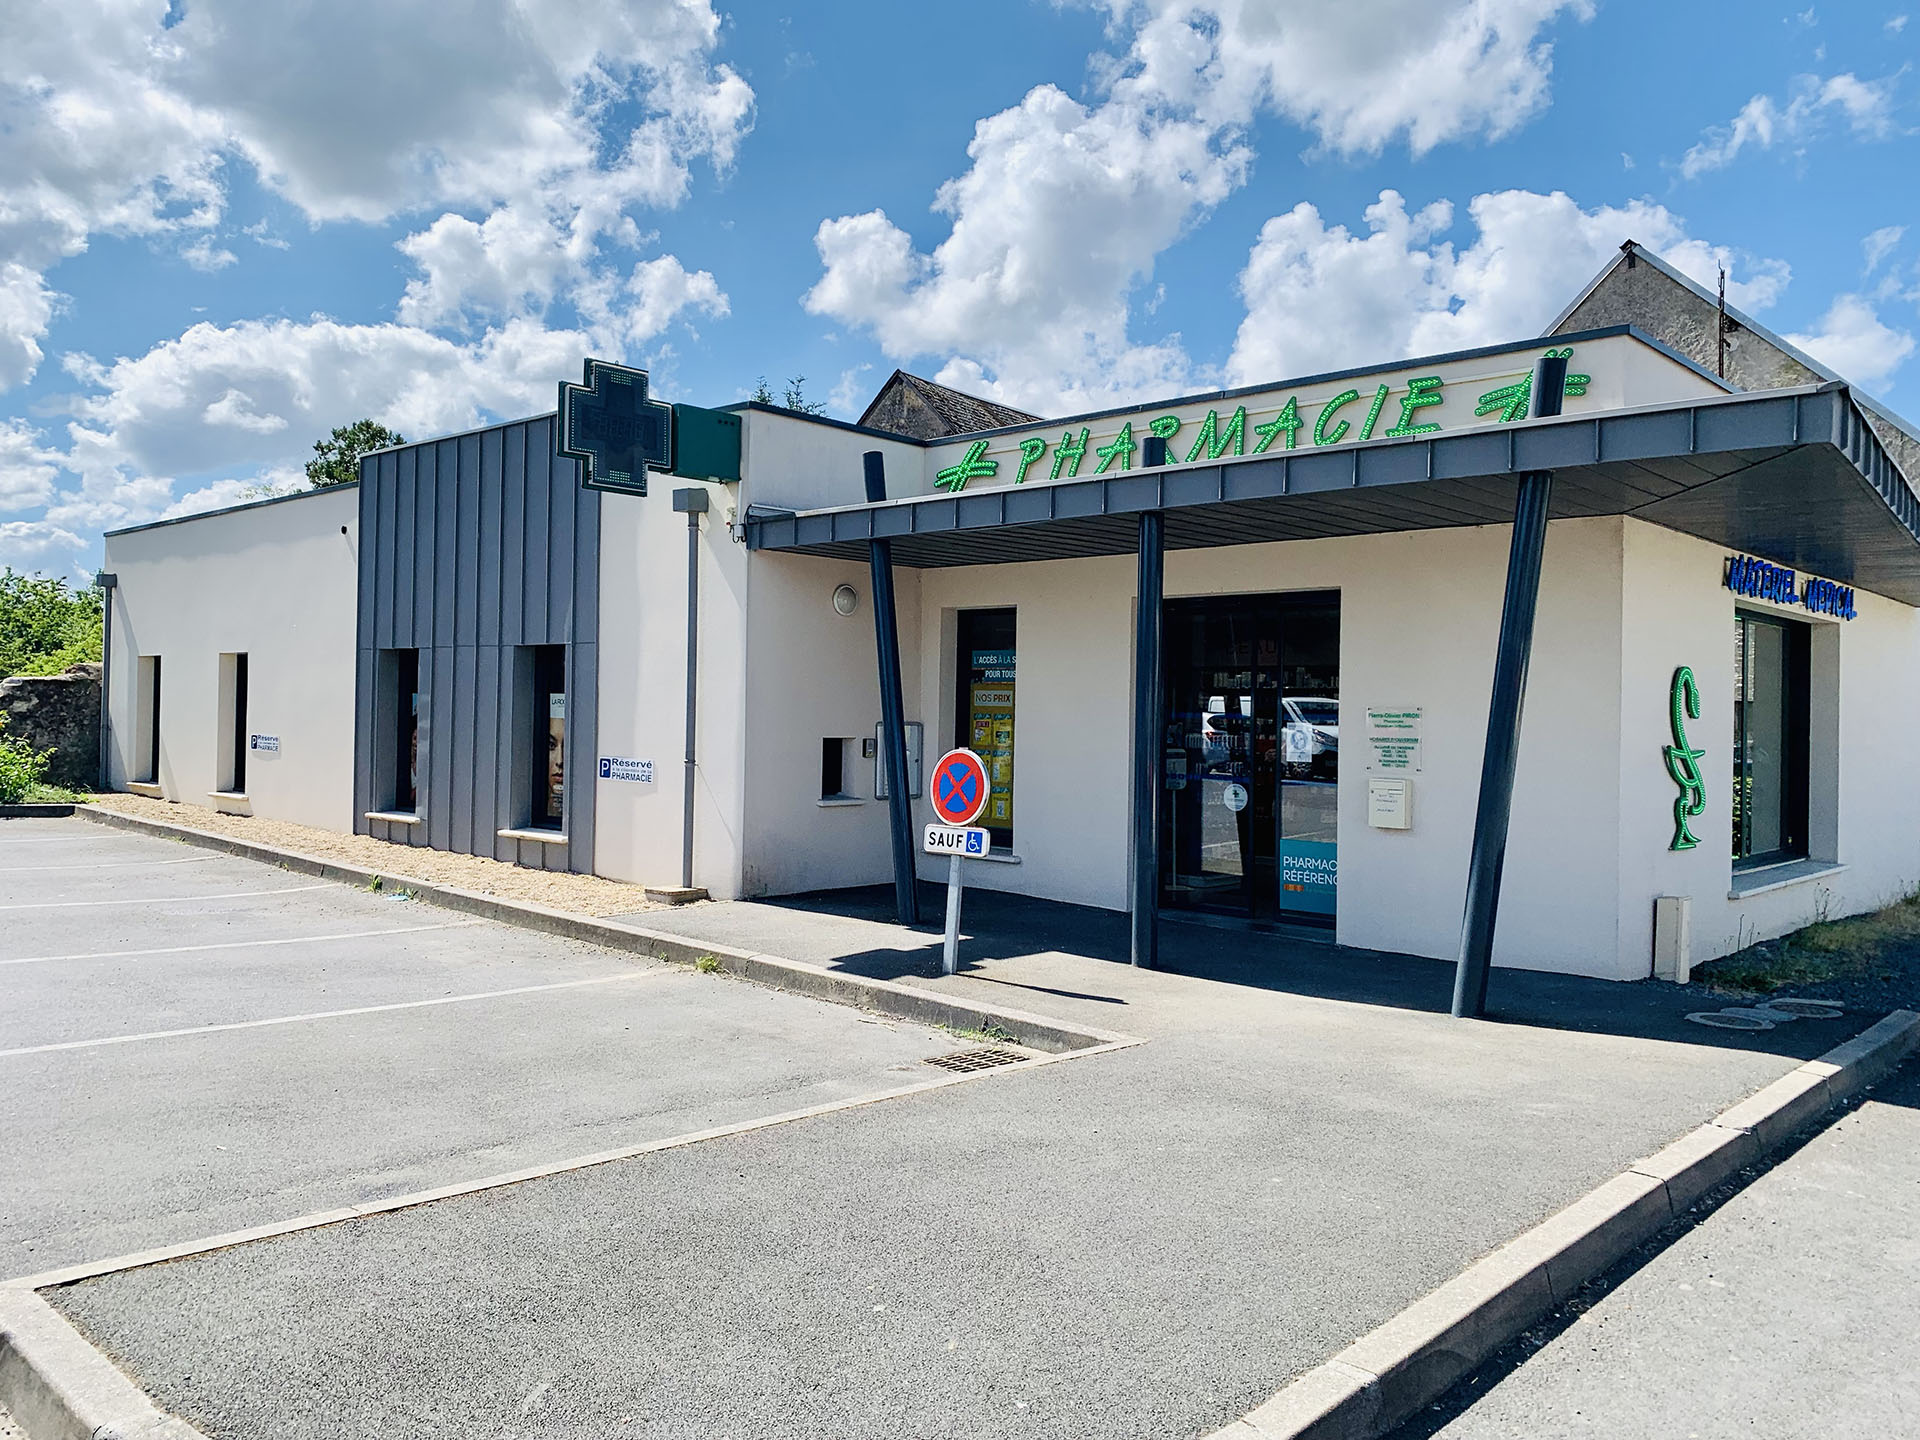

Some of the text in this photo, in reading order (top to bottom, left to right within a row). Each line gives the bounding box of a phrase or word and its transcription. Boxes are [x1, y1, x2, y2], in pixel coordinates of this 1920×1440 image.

[1014, 376, 1444, 484] PHARMACIE
[1801, 577, 1857, 621] MEDICAL
[973, 654, 998, 664] L'ACCÈS
[1003, 656, 1011, 664] LA
[985, 670, 1017, 678] POUR TOUS
[975, 693, 1011, 703] NOS PRIX
[611, 758, 653, 769] Réservé
[611, 771, 652, 783] PHARMACIE
[928, 831, 964, 849] SAUF
